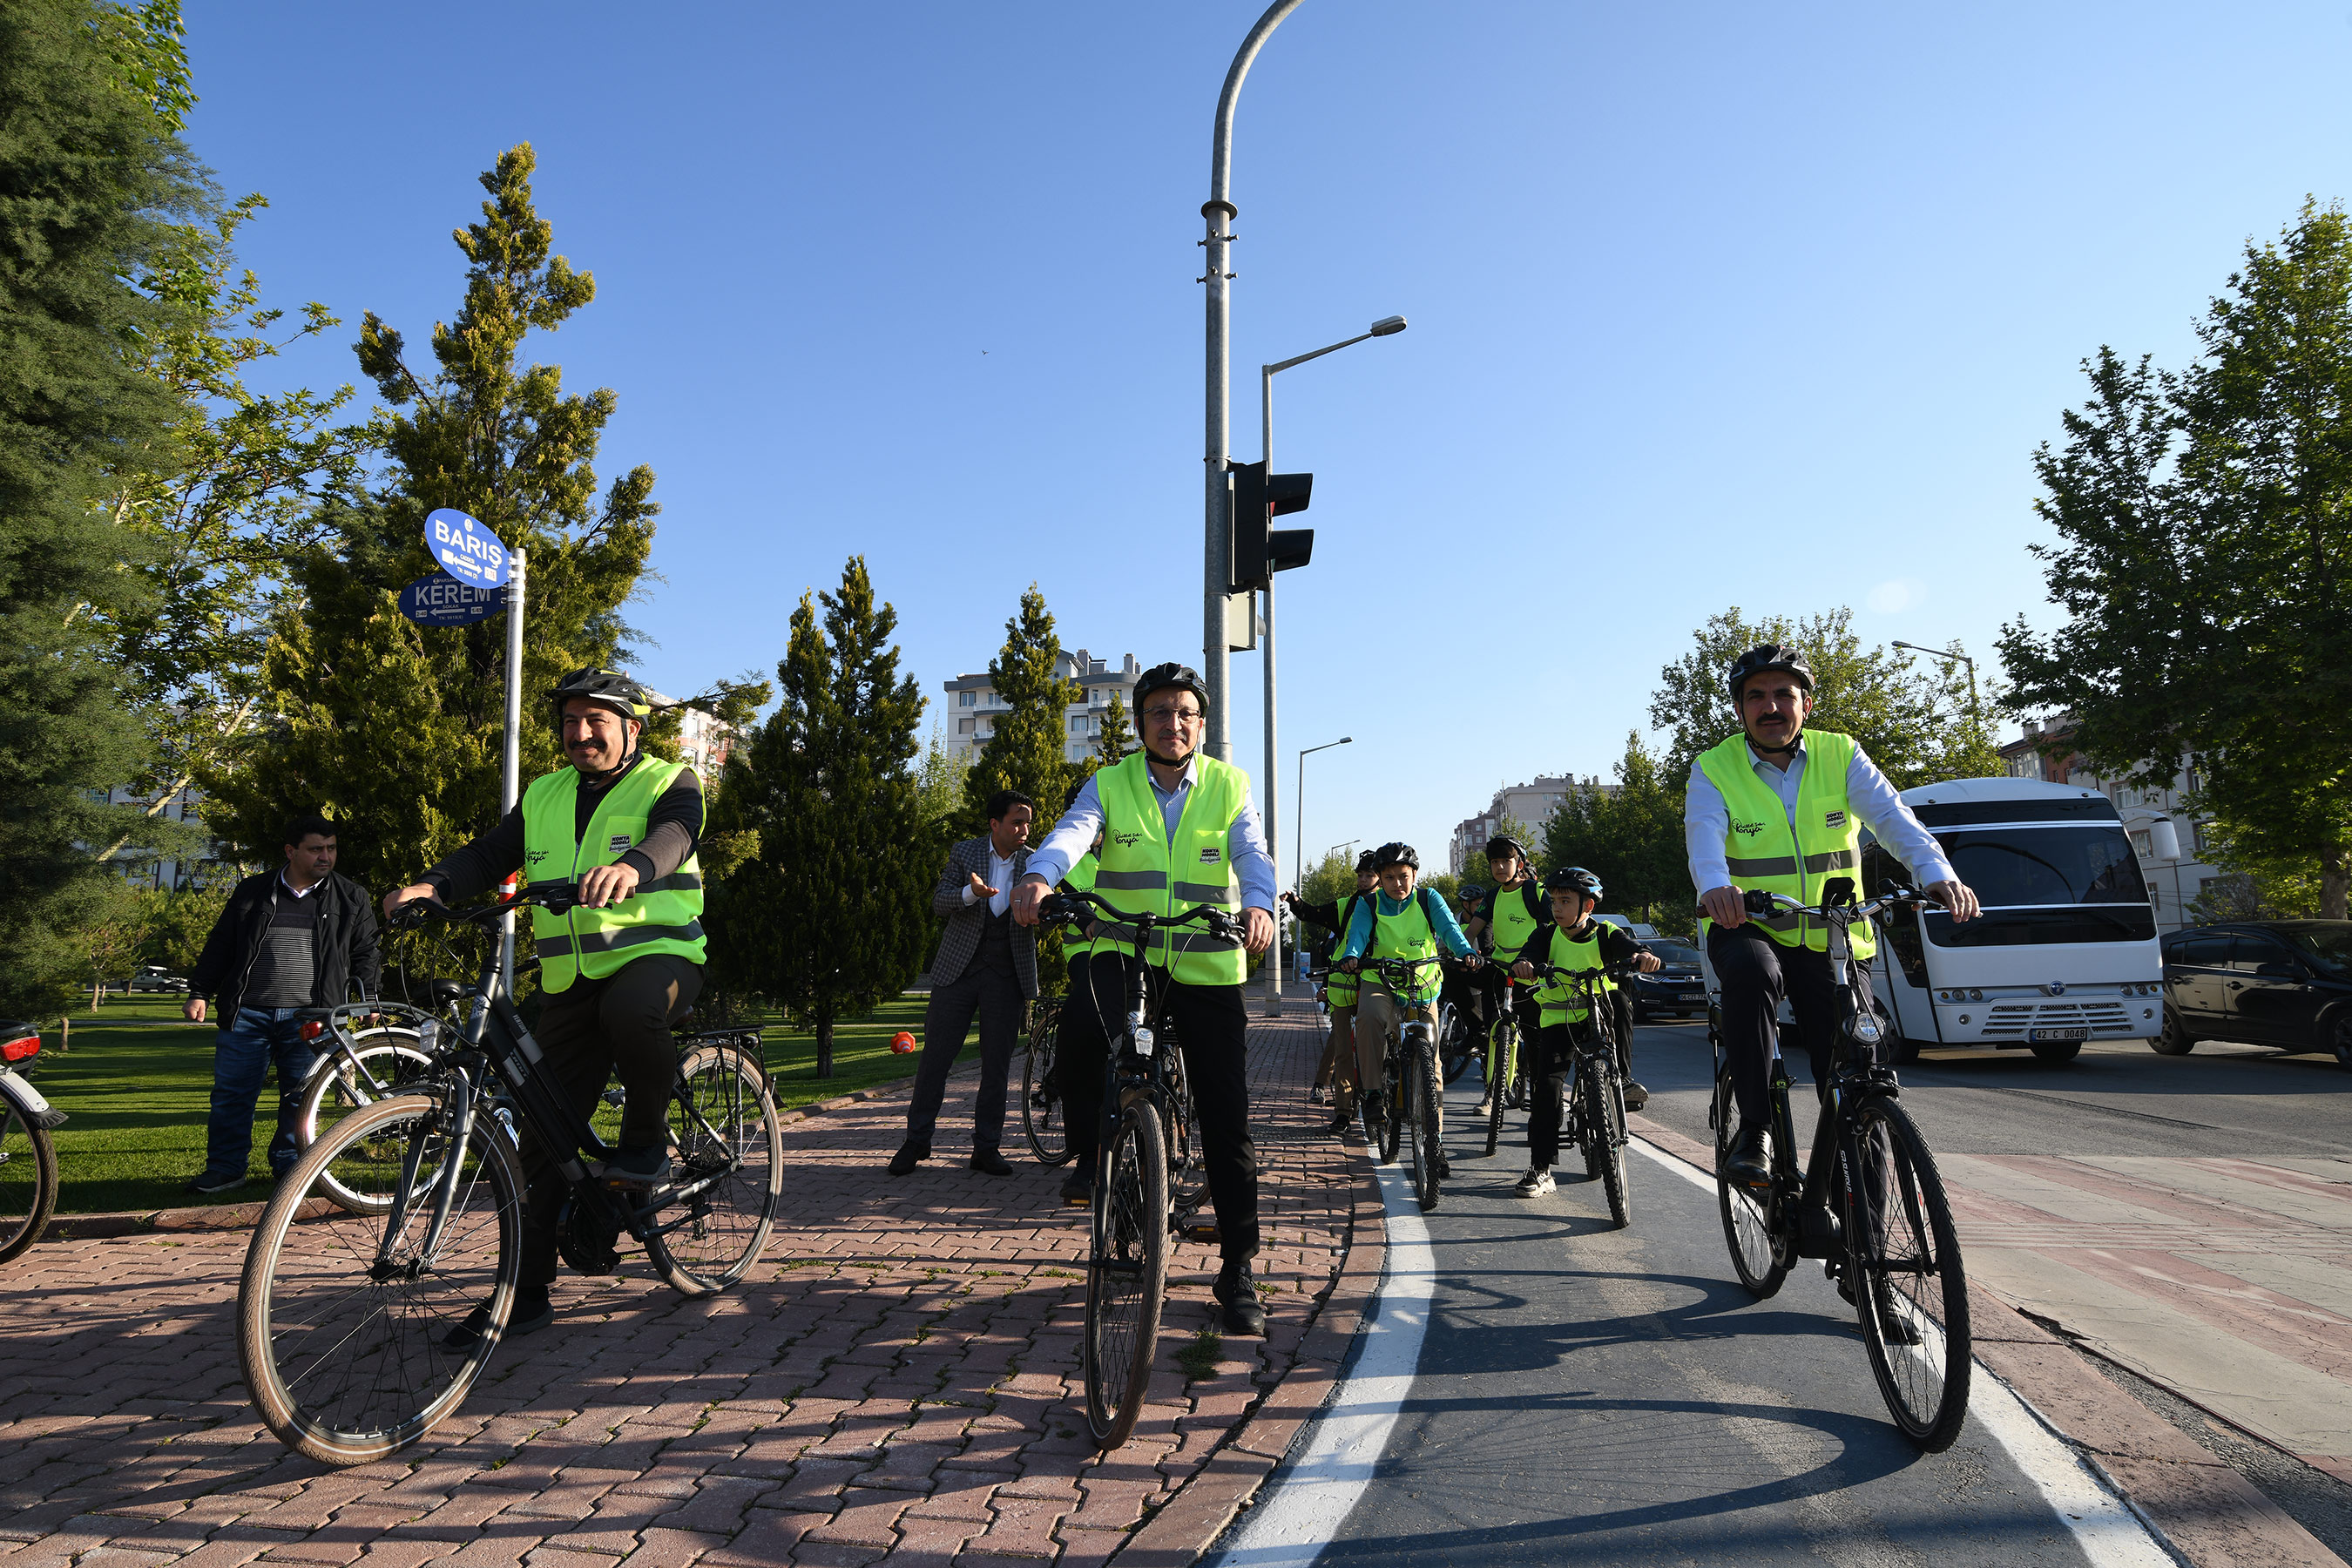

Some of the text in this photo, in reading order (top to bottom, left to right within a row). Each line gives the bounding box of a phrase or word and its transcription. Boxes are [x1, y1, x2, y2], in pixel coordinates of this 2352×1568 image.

[436, 519, 503, 569] BARIŞ
[416, 584, 490, 605] KEREM
[1736, 822, 1763, 837] Konya
[2036, 1029, 2085, 1039] 42 C 0048
